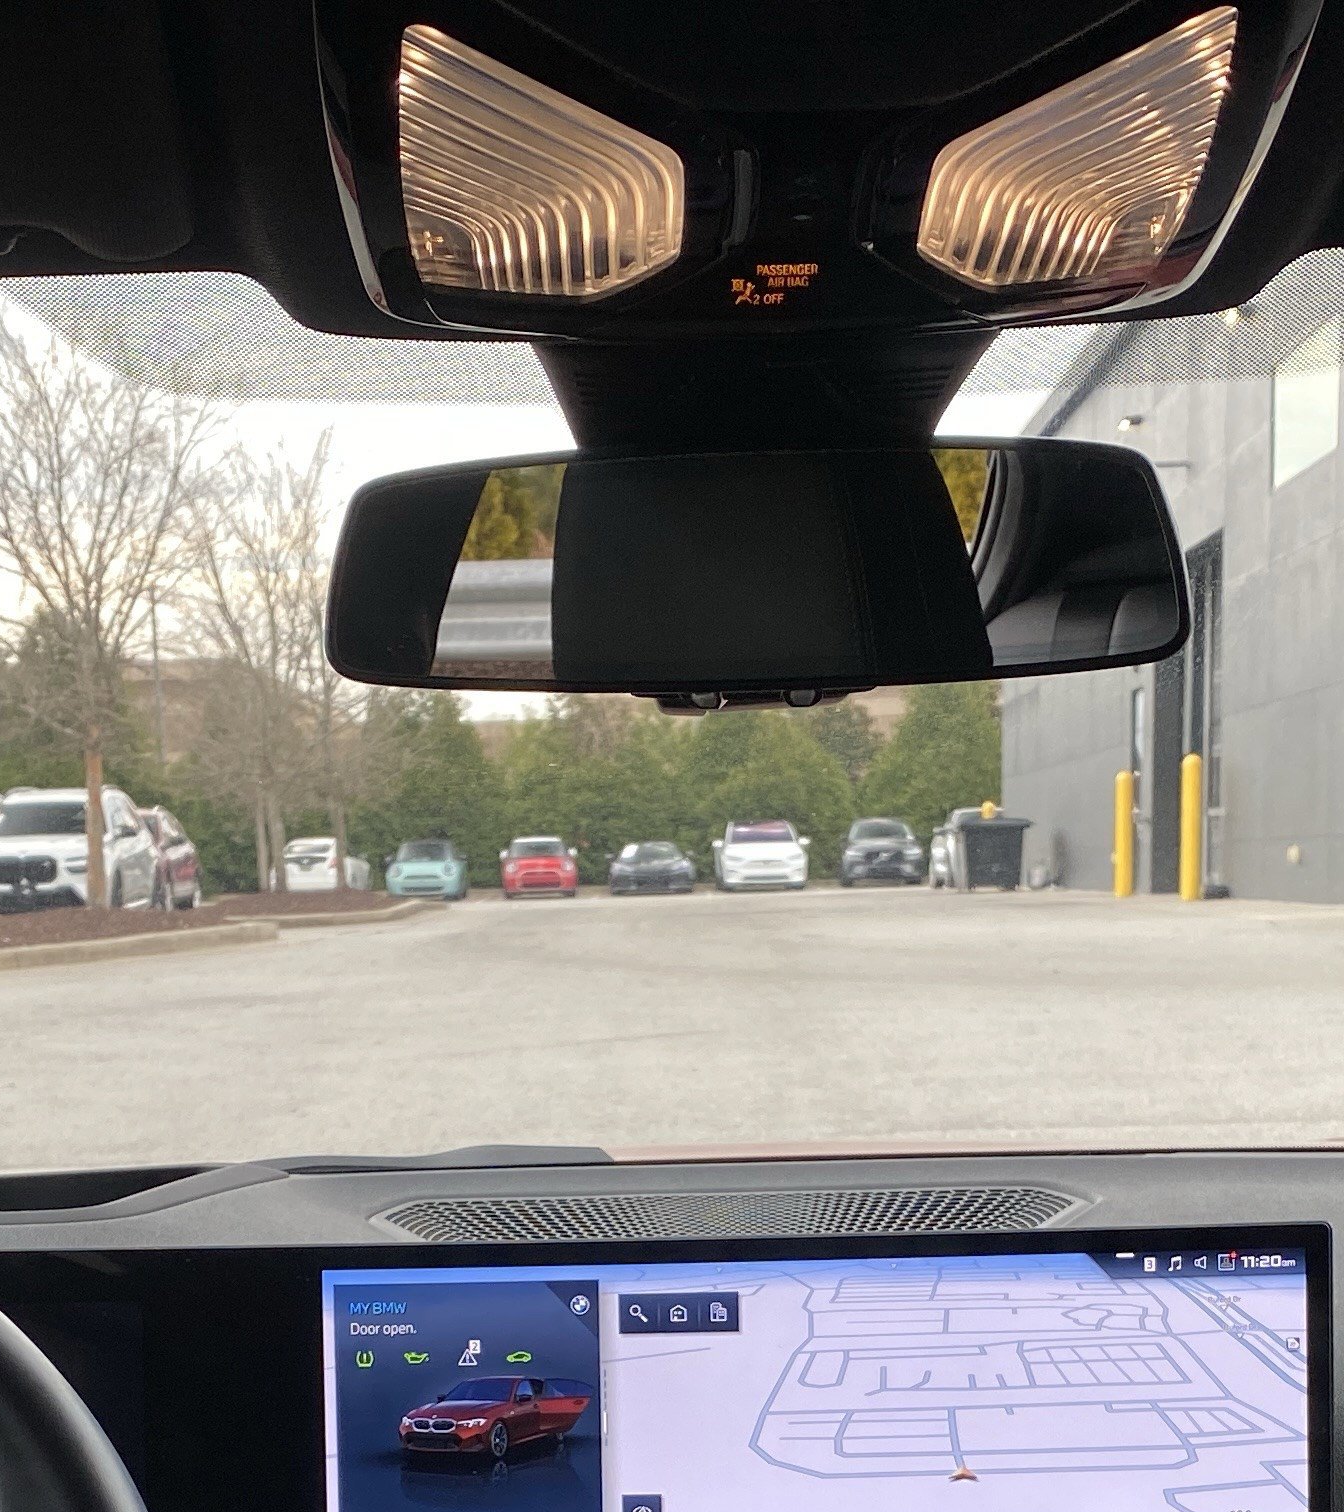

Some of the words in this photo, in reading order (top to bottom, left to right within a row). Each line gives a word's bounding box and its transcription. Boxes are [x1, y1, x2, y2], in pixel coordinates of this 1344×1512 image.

[756, 263, 818, 276] PASSENGER
[767, 276, 784, 287] AIR
[787, 276, 809, 287] BAG
[763, 293, 784, 305] OFF
[349, 1302, 370, 1315] MY
[372, 1301, 407, 1315] BMW
[350, 1322, 380, 1336] Door
[382, 1323, 418, 1337] open.
